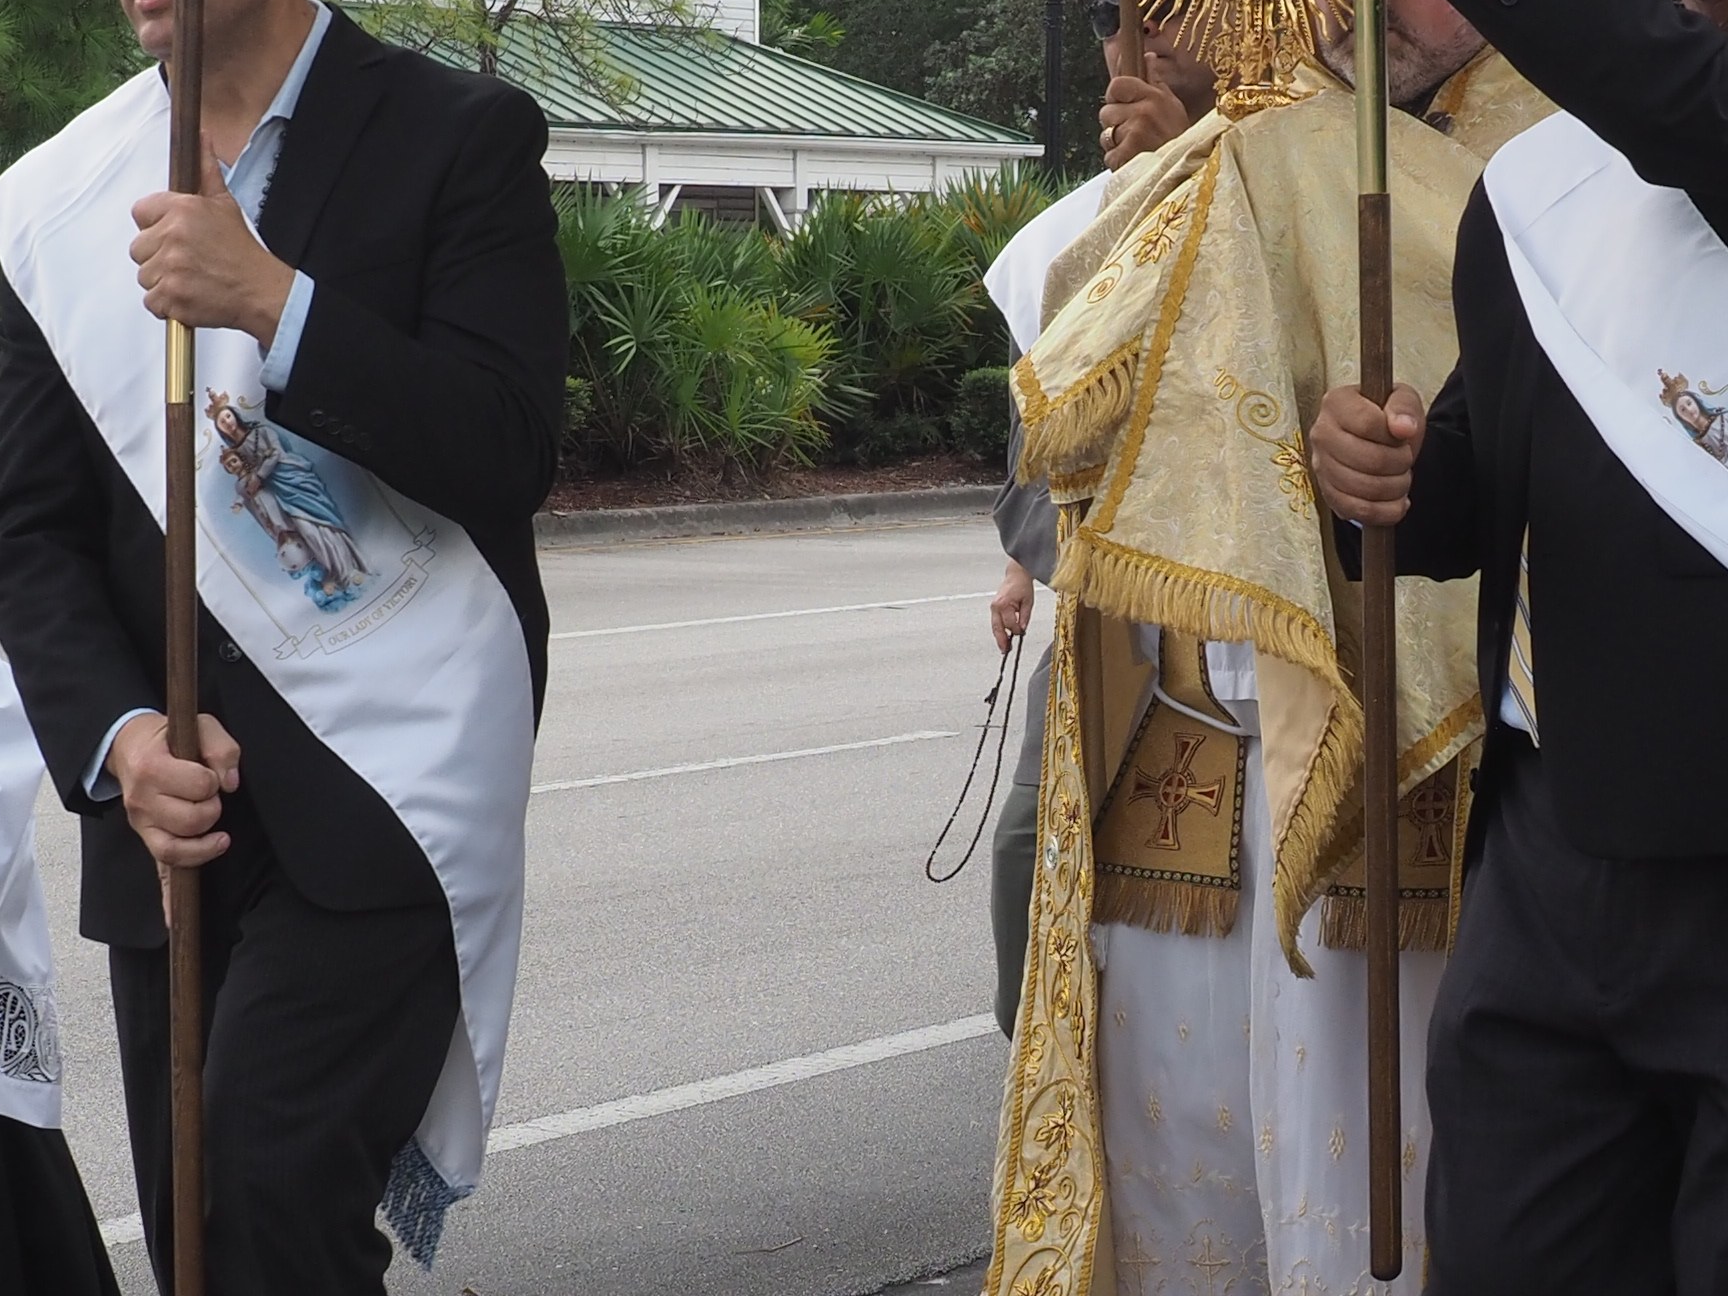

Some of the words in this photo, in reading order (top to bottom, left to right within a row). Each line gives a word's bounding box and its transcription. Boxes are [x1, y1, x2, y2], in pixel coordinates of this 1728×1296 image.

[328, 630, 351, 646] OUR
[348, 615, 372, 636] LADY
[371, 607, 385, 620] OF
[382, 575, 418, 610] VICTORY
